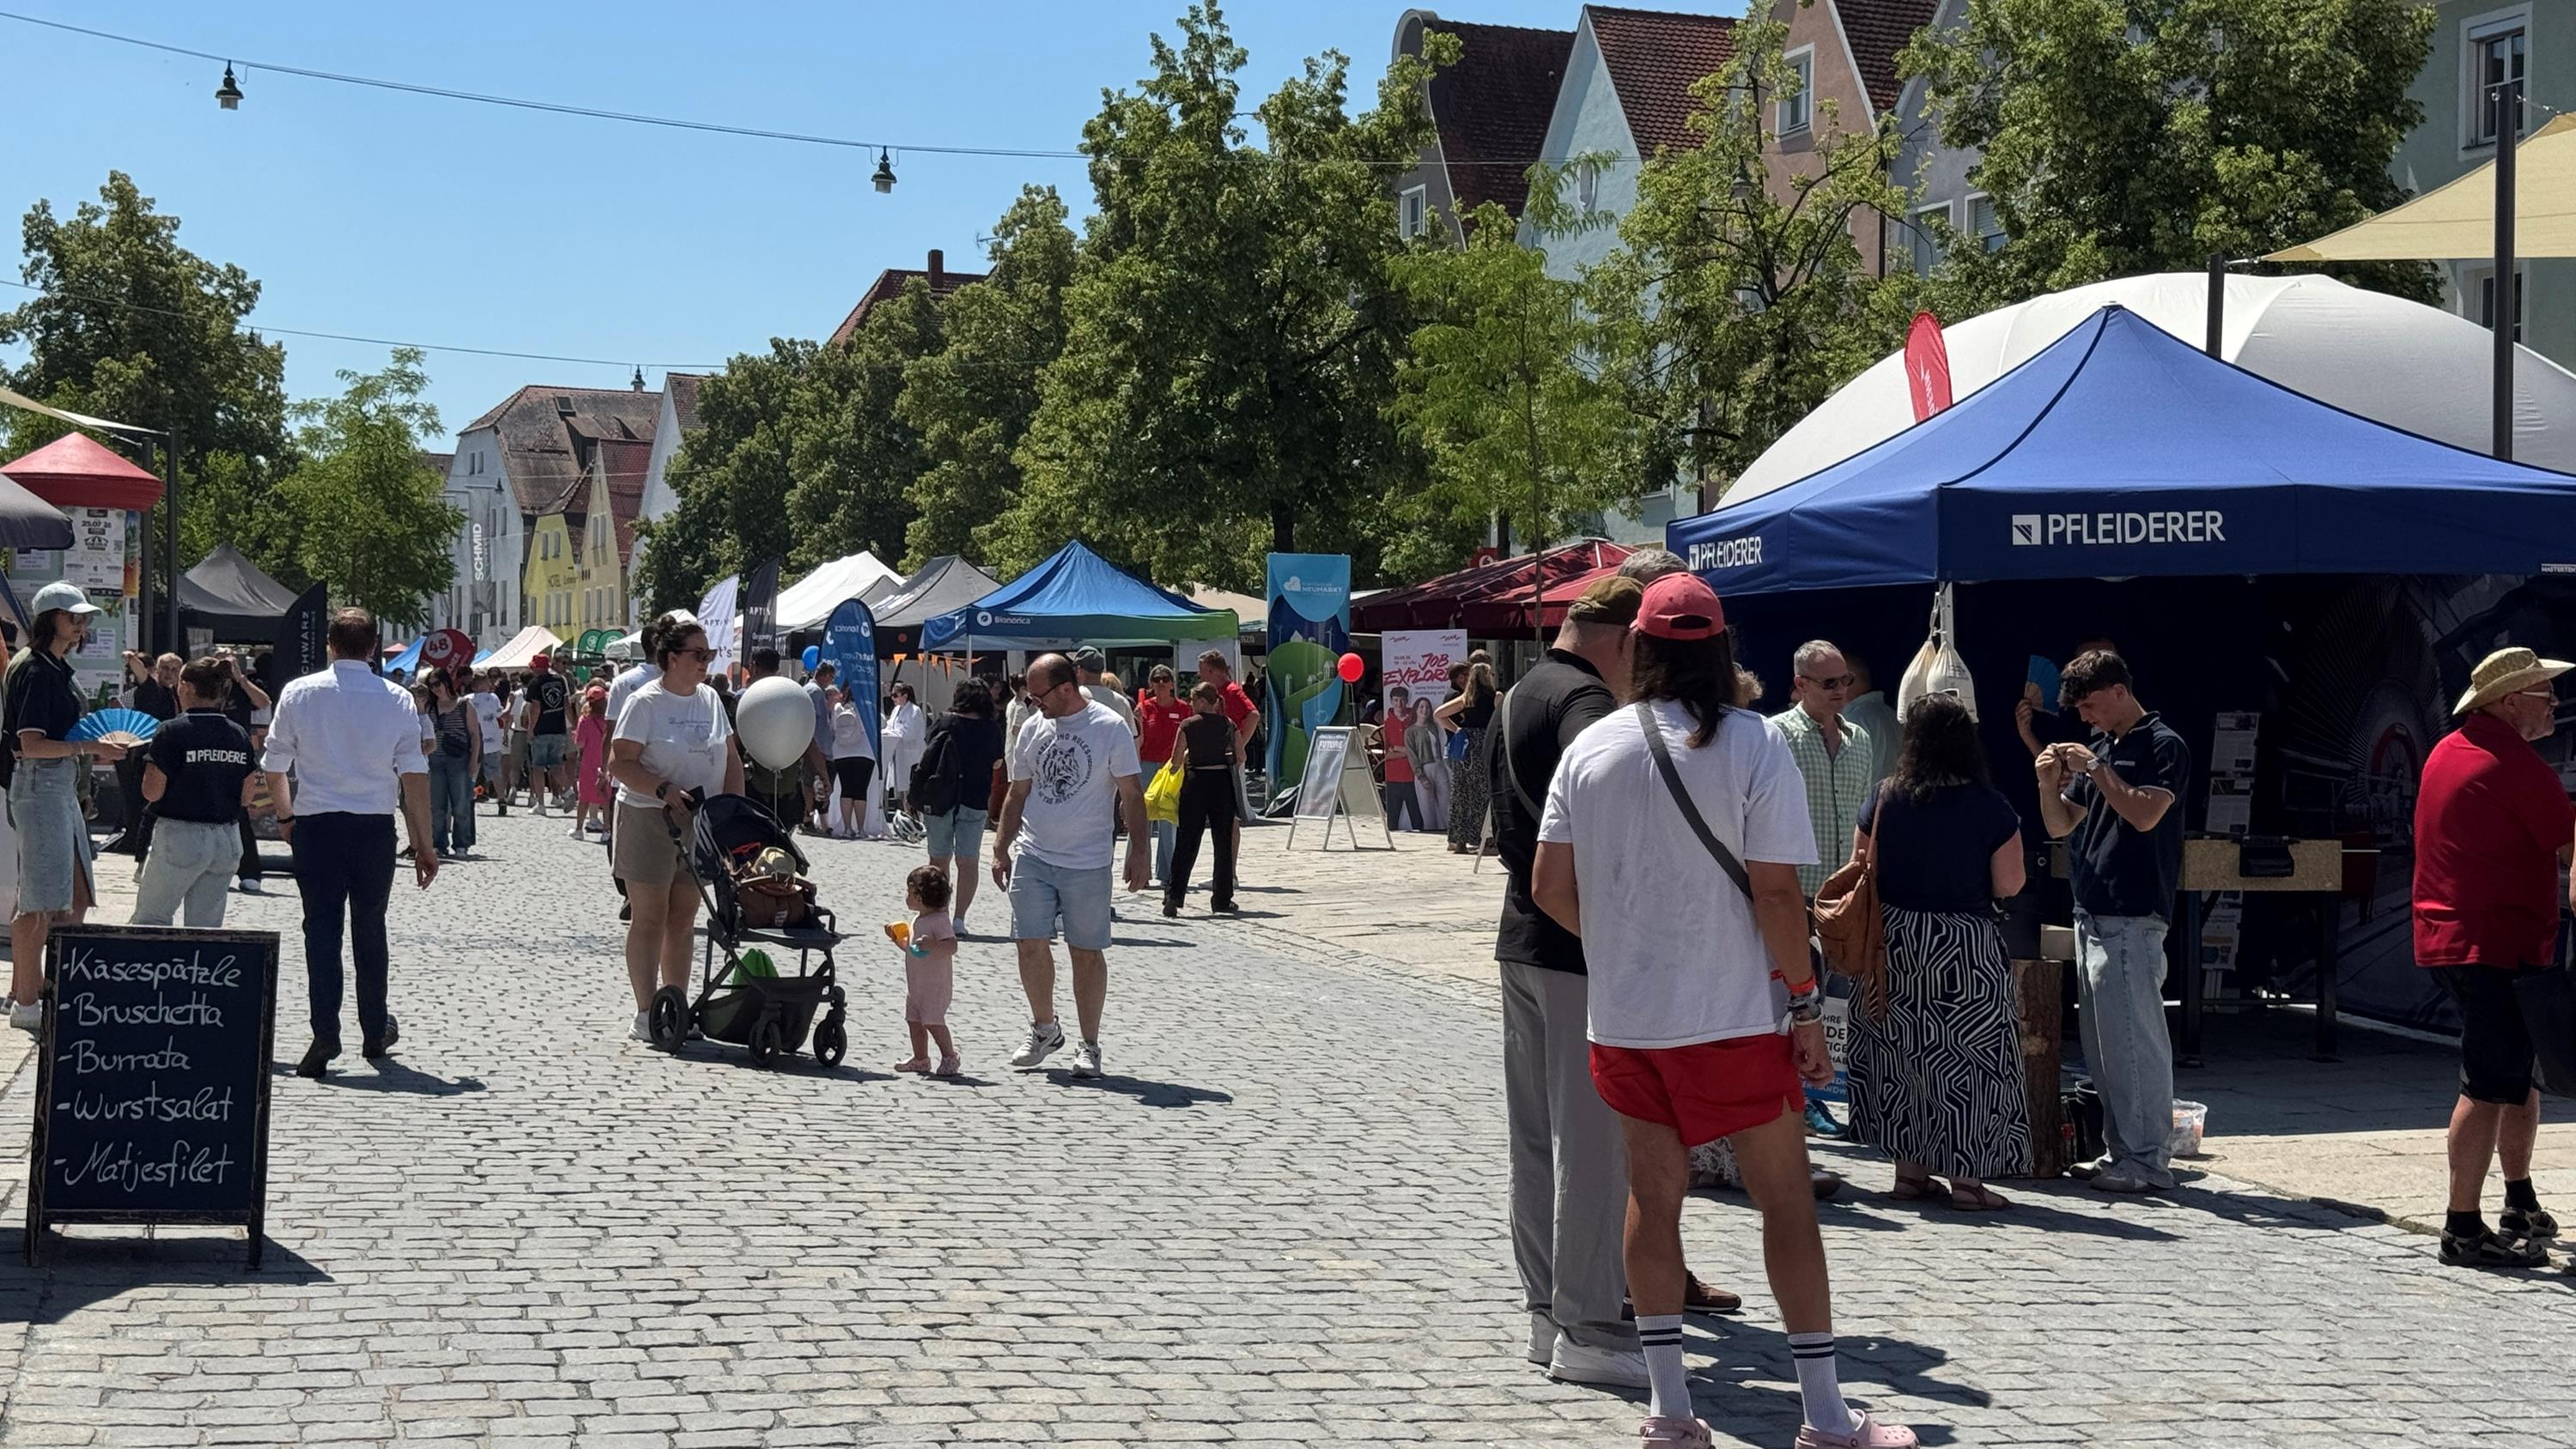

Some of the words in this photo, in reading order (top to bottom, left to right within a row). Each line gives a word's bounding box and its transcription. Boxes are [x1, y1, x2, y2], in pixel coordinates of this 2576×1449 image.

[2047, 511, 2226, 545] PFLEIDERER
[472, 523, 484, 581] SCHMID
[1699, 536, 1763, 570] PFLEIDERER
[994, 615, 1031, 626] Bionorica
[1419, 652, 1449, 670] JOB
[1318, 740, 1344, 749] FUTURE
